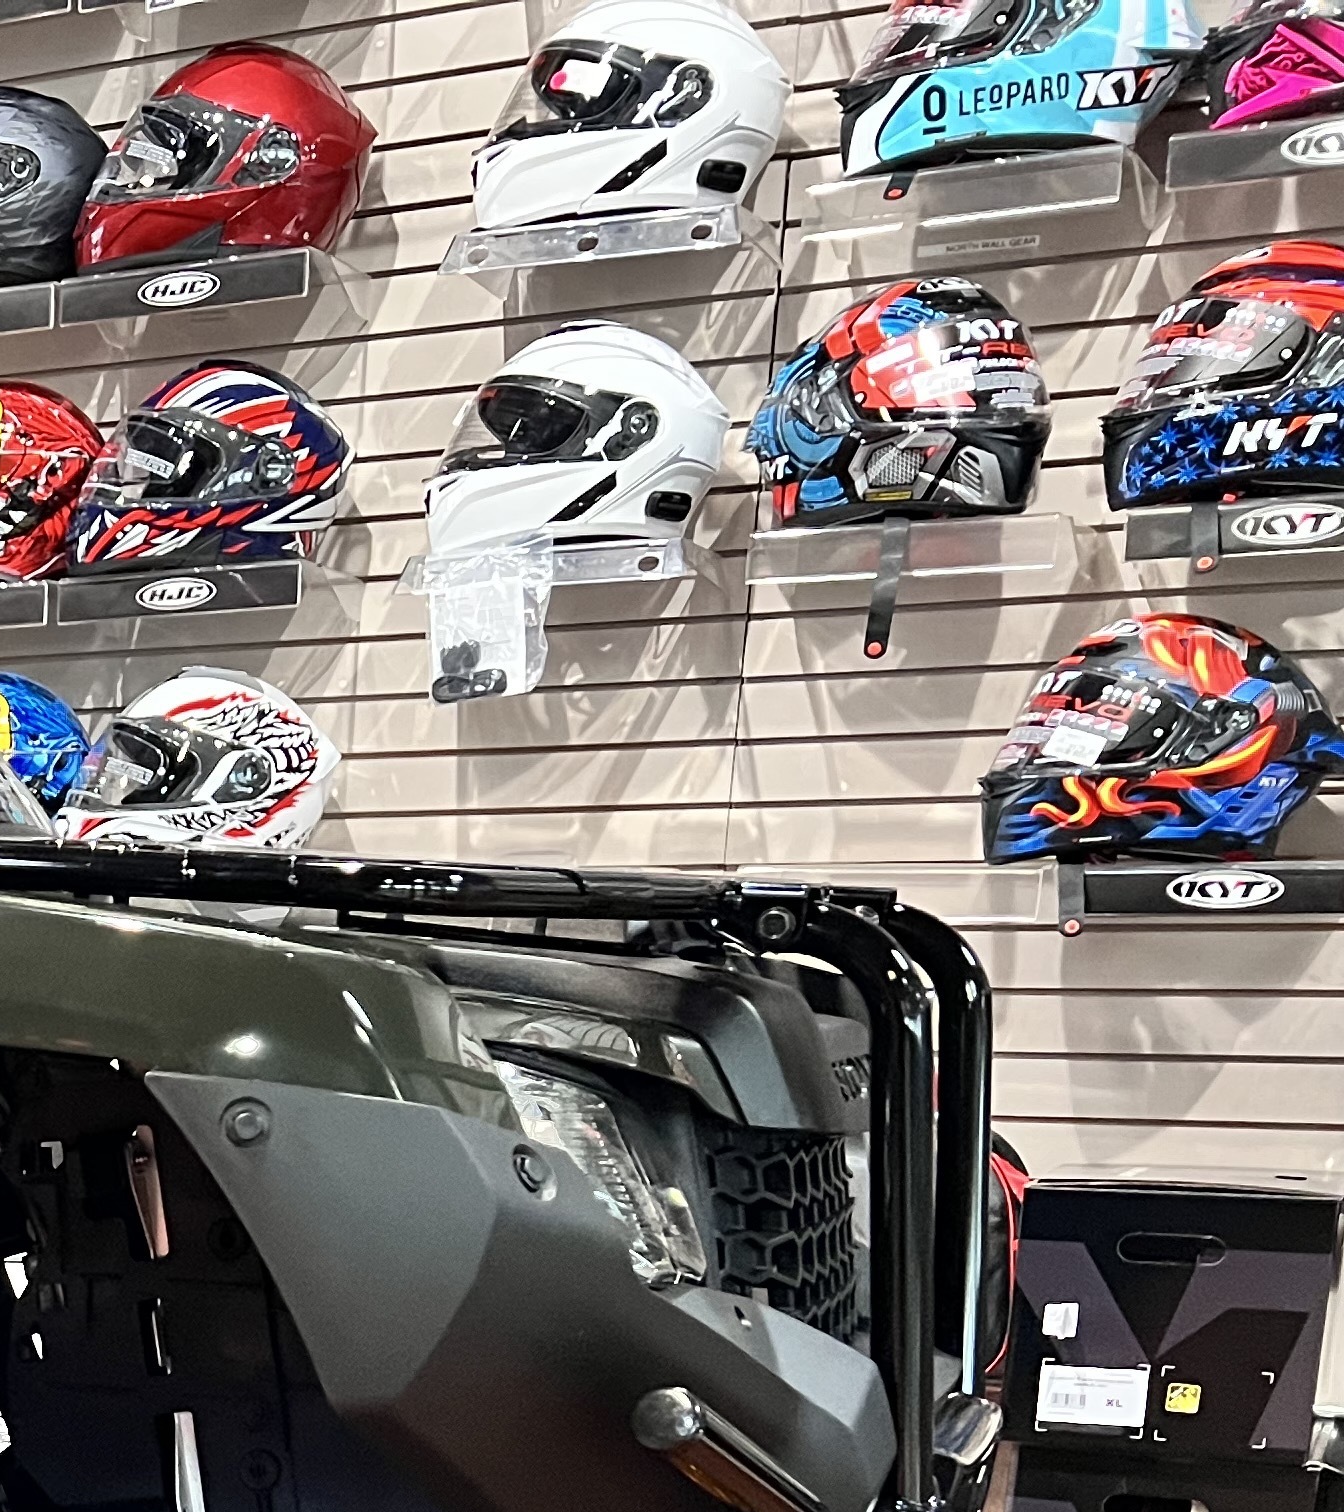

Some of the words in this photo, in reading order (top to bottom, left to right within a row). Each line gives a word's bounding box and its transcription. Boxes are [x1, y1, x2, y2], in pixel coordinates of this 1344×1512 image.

[959, 73, 1069, 116] LEOPARD
[1080, 66, 1170, 109] KYT
[946, 243, 979, 253] NORTH
[982, 240, 1006, 250] WALL
[1009, 236, 1037, 247] GEAR
[152, 275, 210, 298] HJC
[1223, 413, 1339, 456] KYT
[1246, 511, 1337, 536] KYT
[148, 585, 205, 603] HJC
[1184, 881, 1264, 899] KYT
